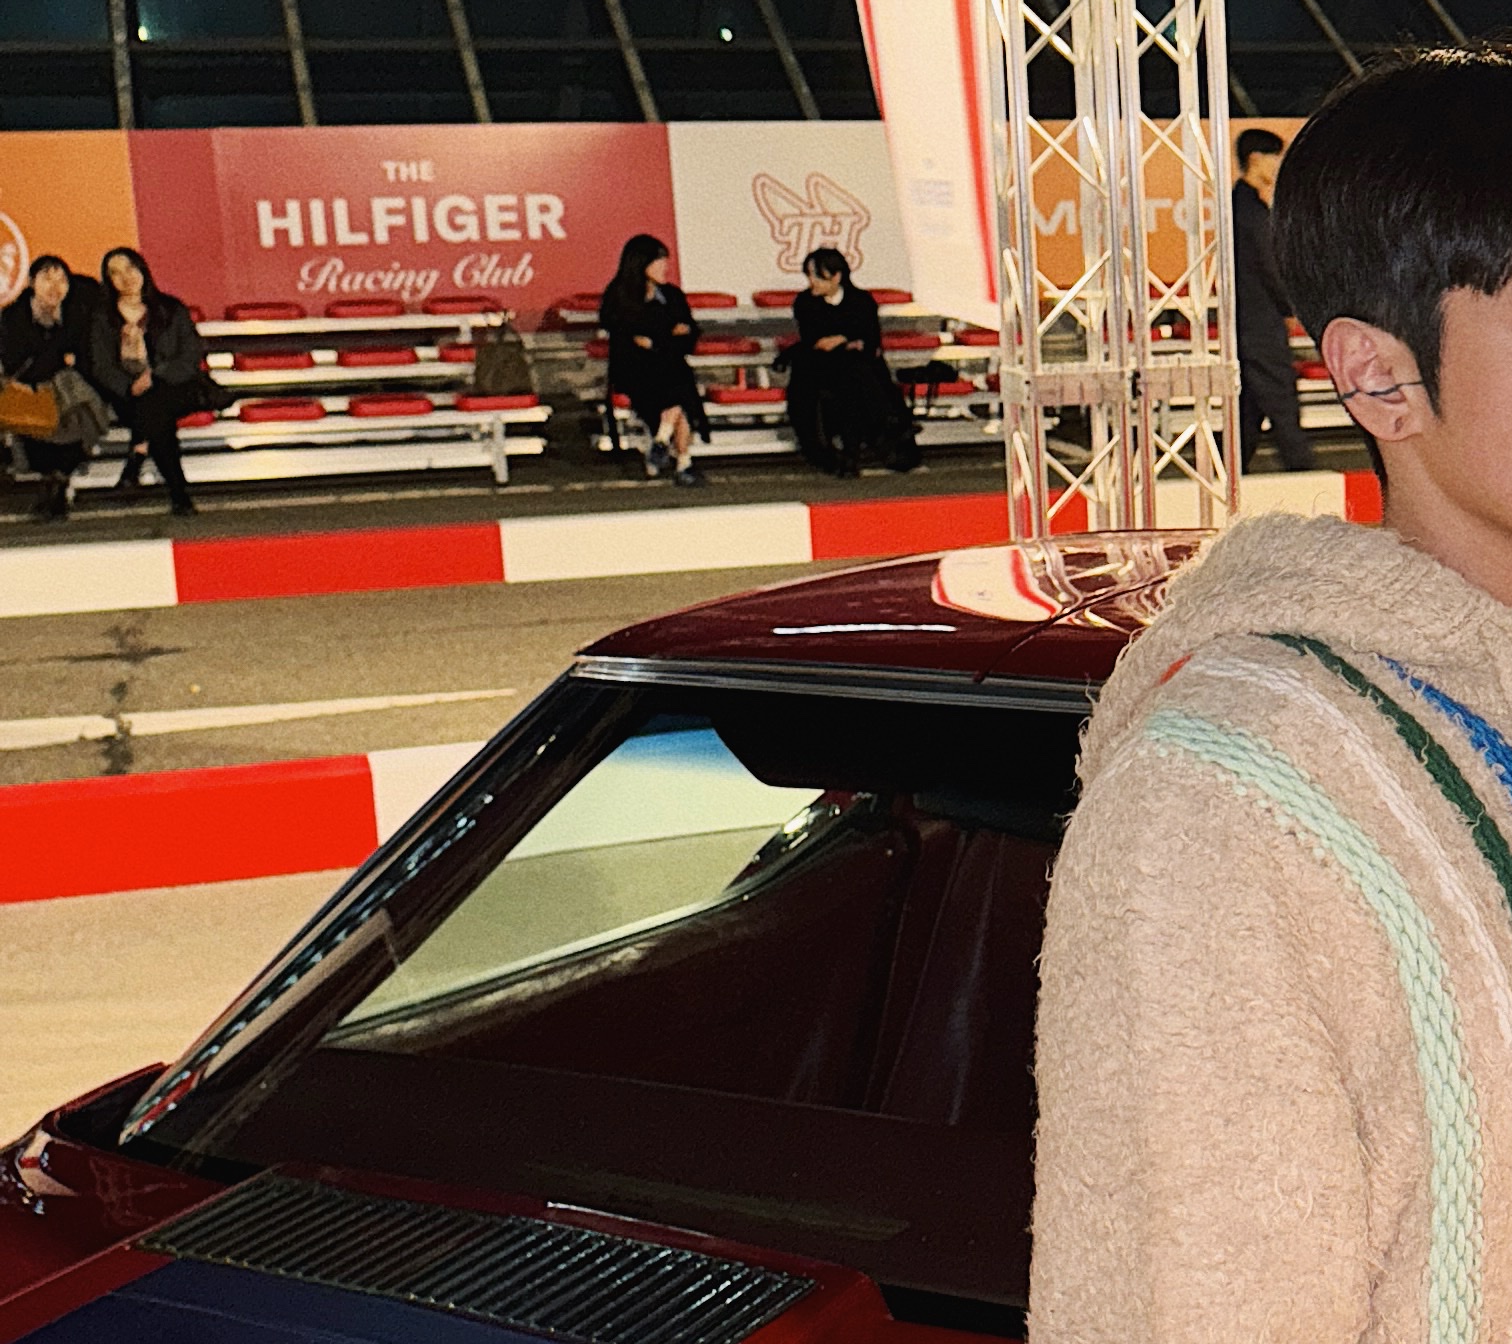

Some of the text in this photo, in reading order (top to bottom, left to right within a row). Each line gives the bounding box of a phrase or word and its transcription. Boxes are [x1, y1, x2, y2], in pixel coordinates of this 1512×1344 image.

[381, 160, 434, 182] THE
[257, 193, 566, 248] HILFIGER
[298, 252, 534, 302] Racing Club
